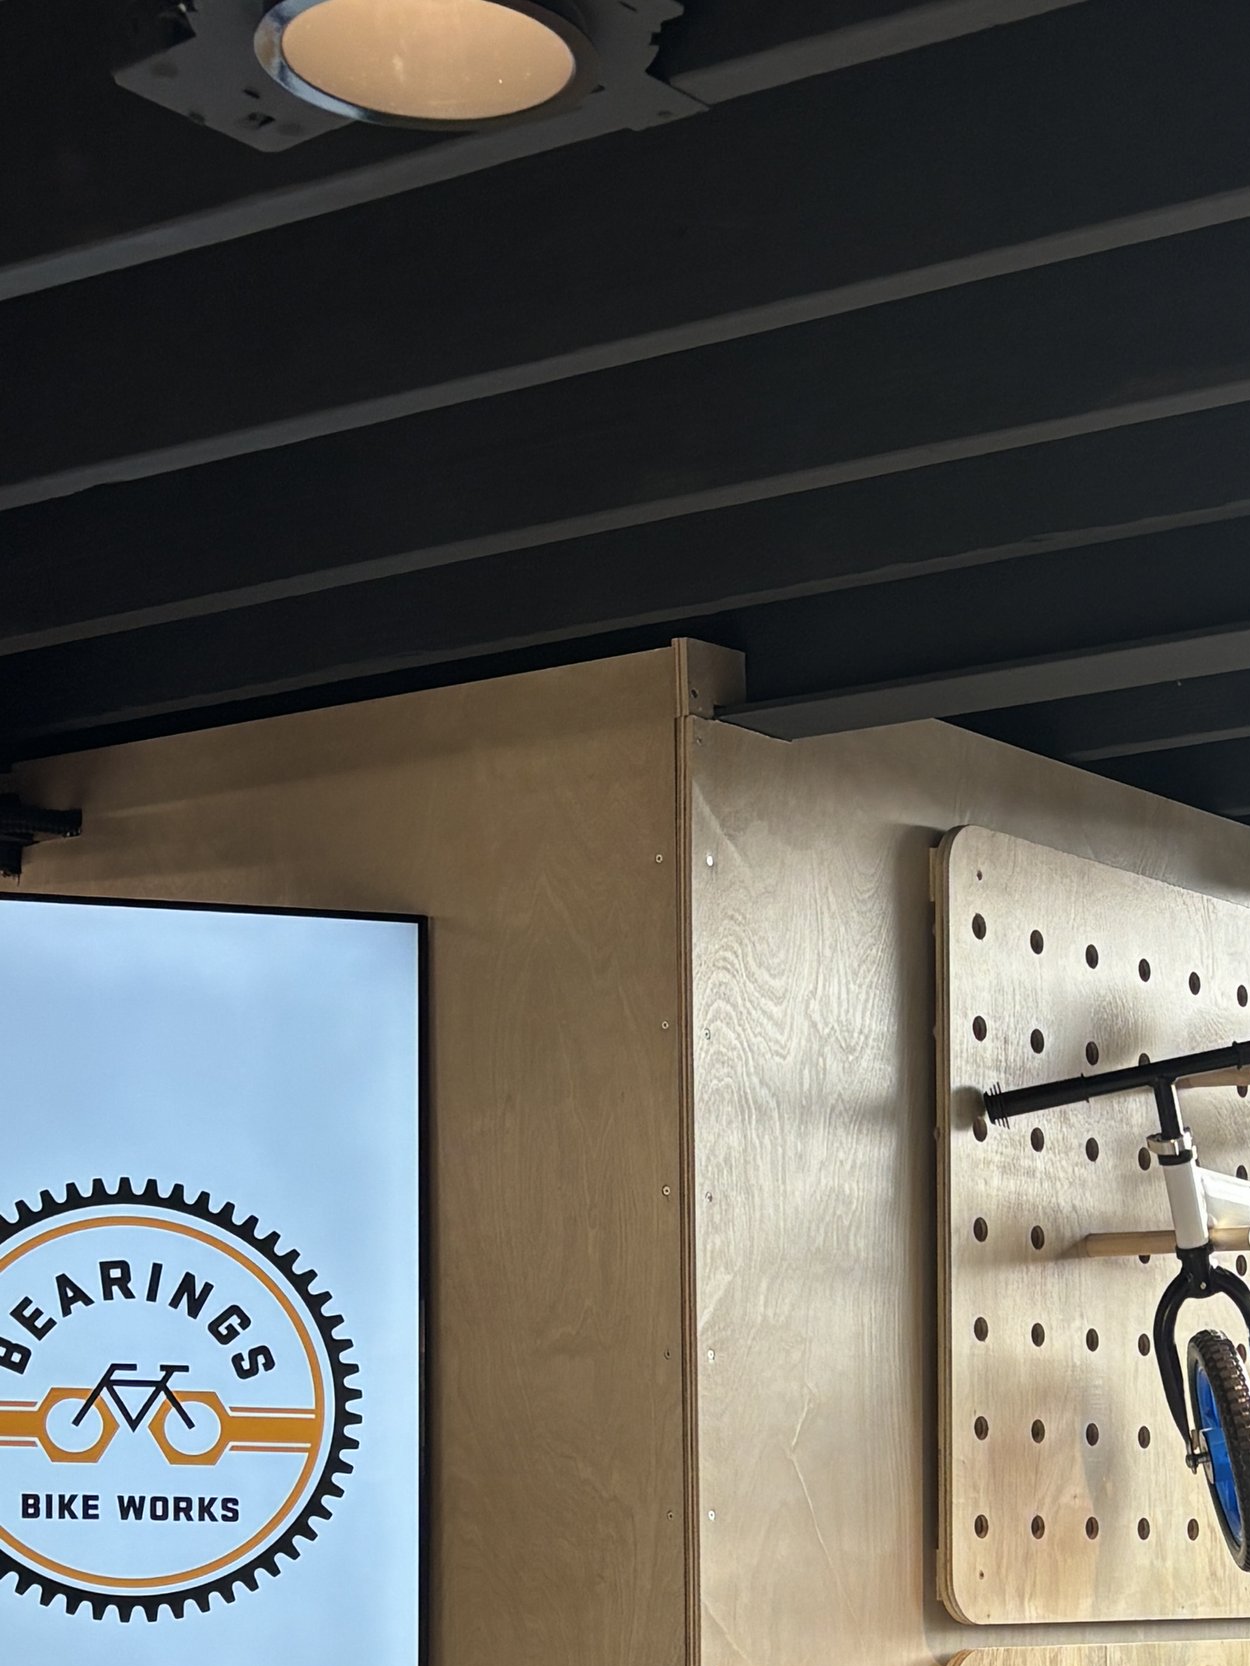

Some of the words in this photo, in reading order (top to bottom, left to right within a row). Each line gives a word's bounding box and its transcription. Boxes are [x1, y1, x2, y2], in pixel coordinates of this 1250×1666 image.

[0, 1259, 276, 1380] BEARINGS
[21, 1493, 99, 1520] BIKE
[118, 1494, 239, 1522] WORKS
